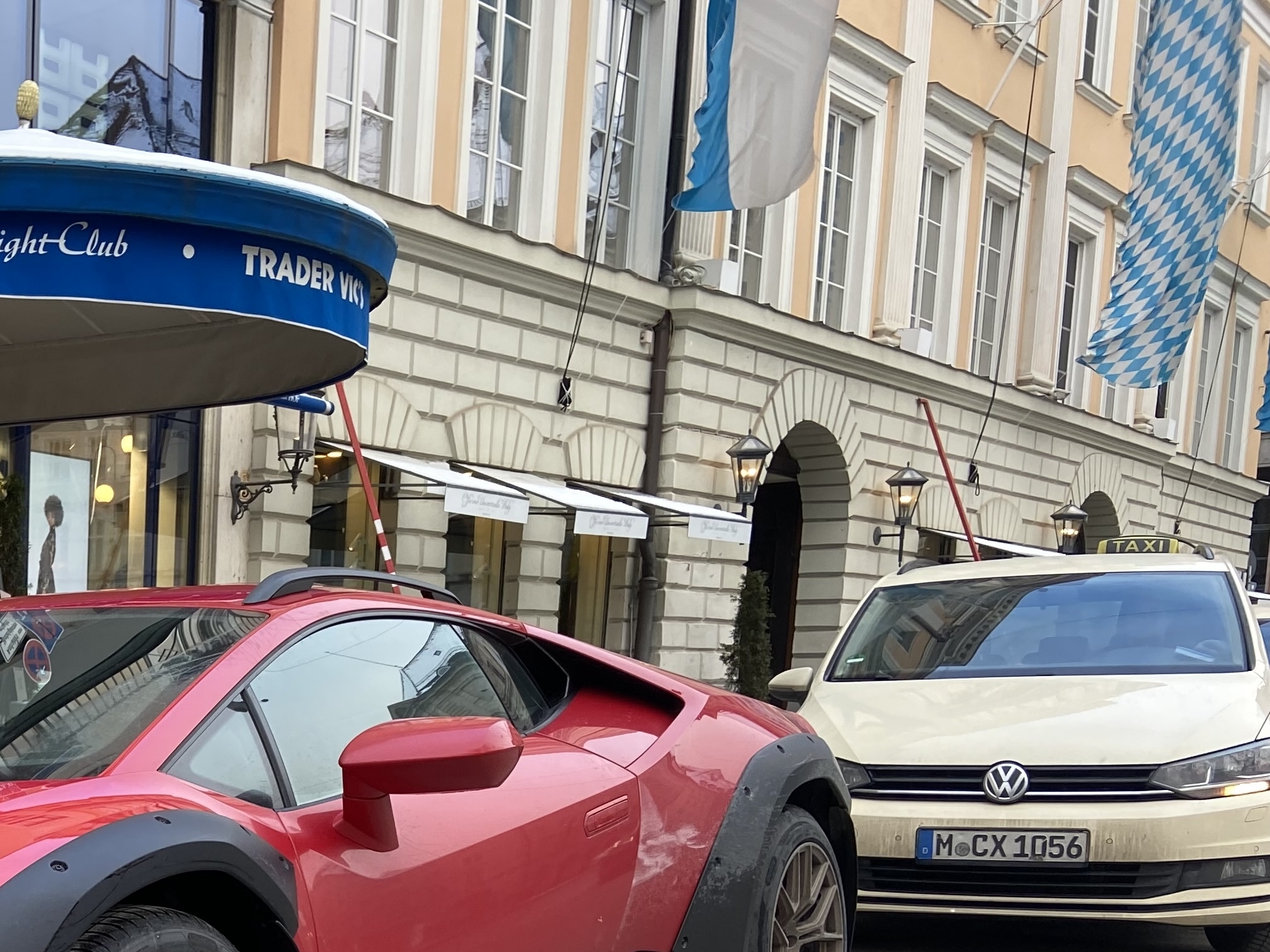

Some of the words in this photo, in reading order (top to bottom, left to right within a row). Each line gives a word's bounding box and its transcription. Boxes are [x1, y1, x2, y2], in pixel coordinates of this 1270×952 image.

[242, 245, 335, 293] TRADER
[1113, 540, 1164, 552] TAXI
[935, 834, 953, 856] M
